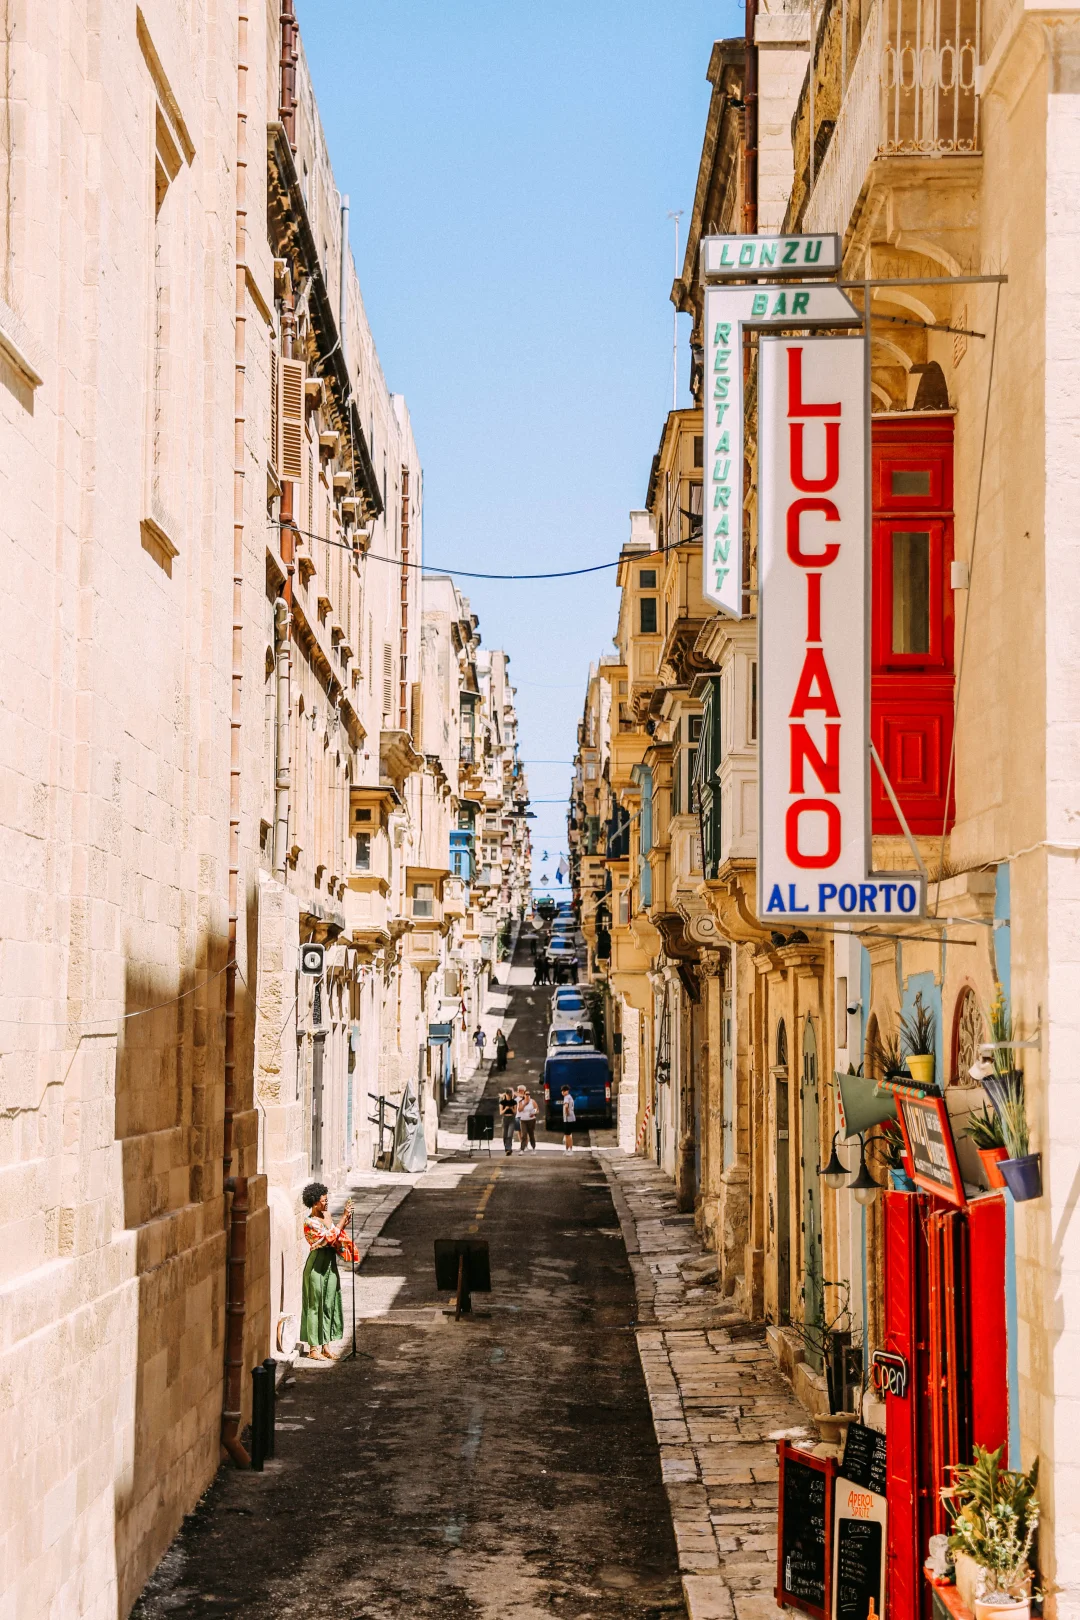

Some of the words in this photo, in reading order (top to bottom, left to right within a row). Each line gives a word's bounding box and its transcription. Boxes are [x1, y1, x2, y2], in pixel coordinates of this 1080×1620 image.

[720, 240, 823, 266] LONZU
[752, 292, 811, 316] BAR
[713, 322, 732, 590] RESTAURANT
[785, 347, 842, 870] LUCIANO
[766, 883, 809, 912] AL
[818, 883, 917, 913] PORTO
[848, 1490, 874, 1508] APEROL
